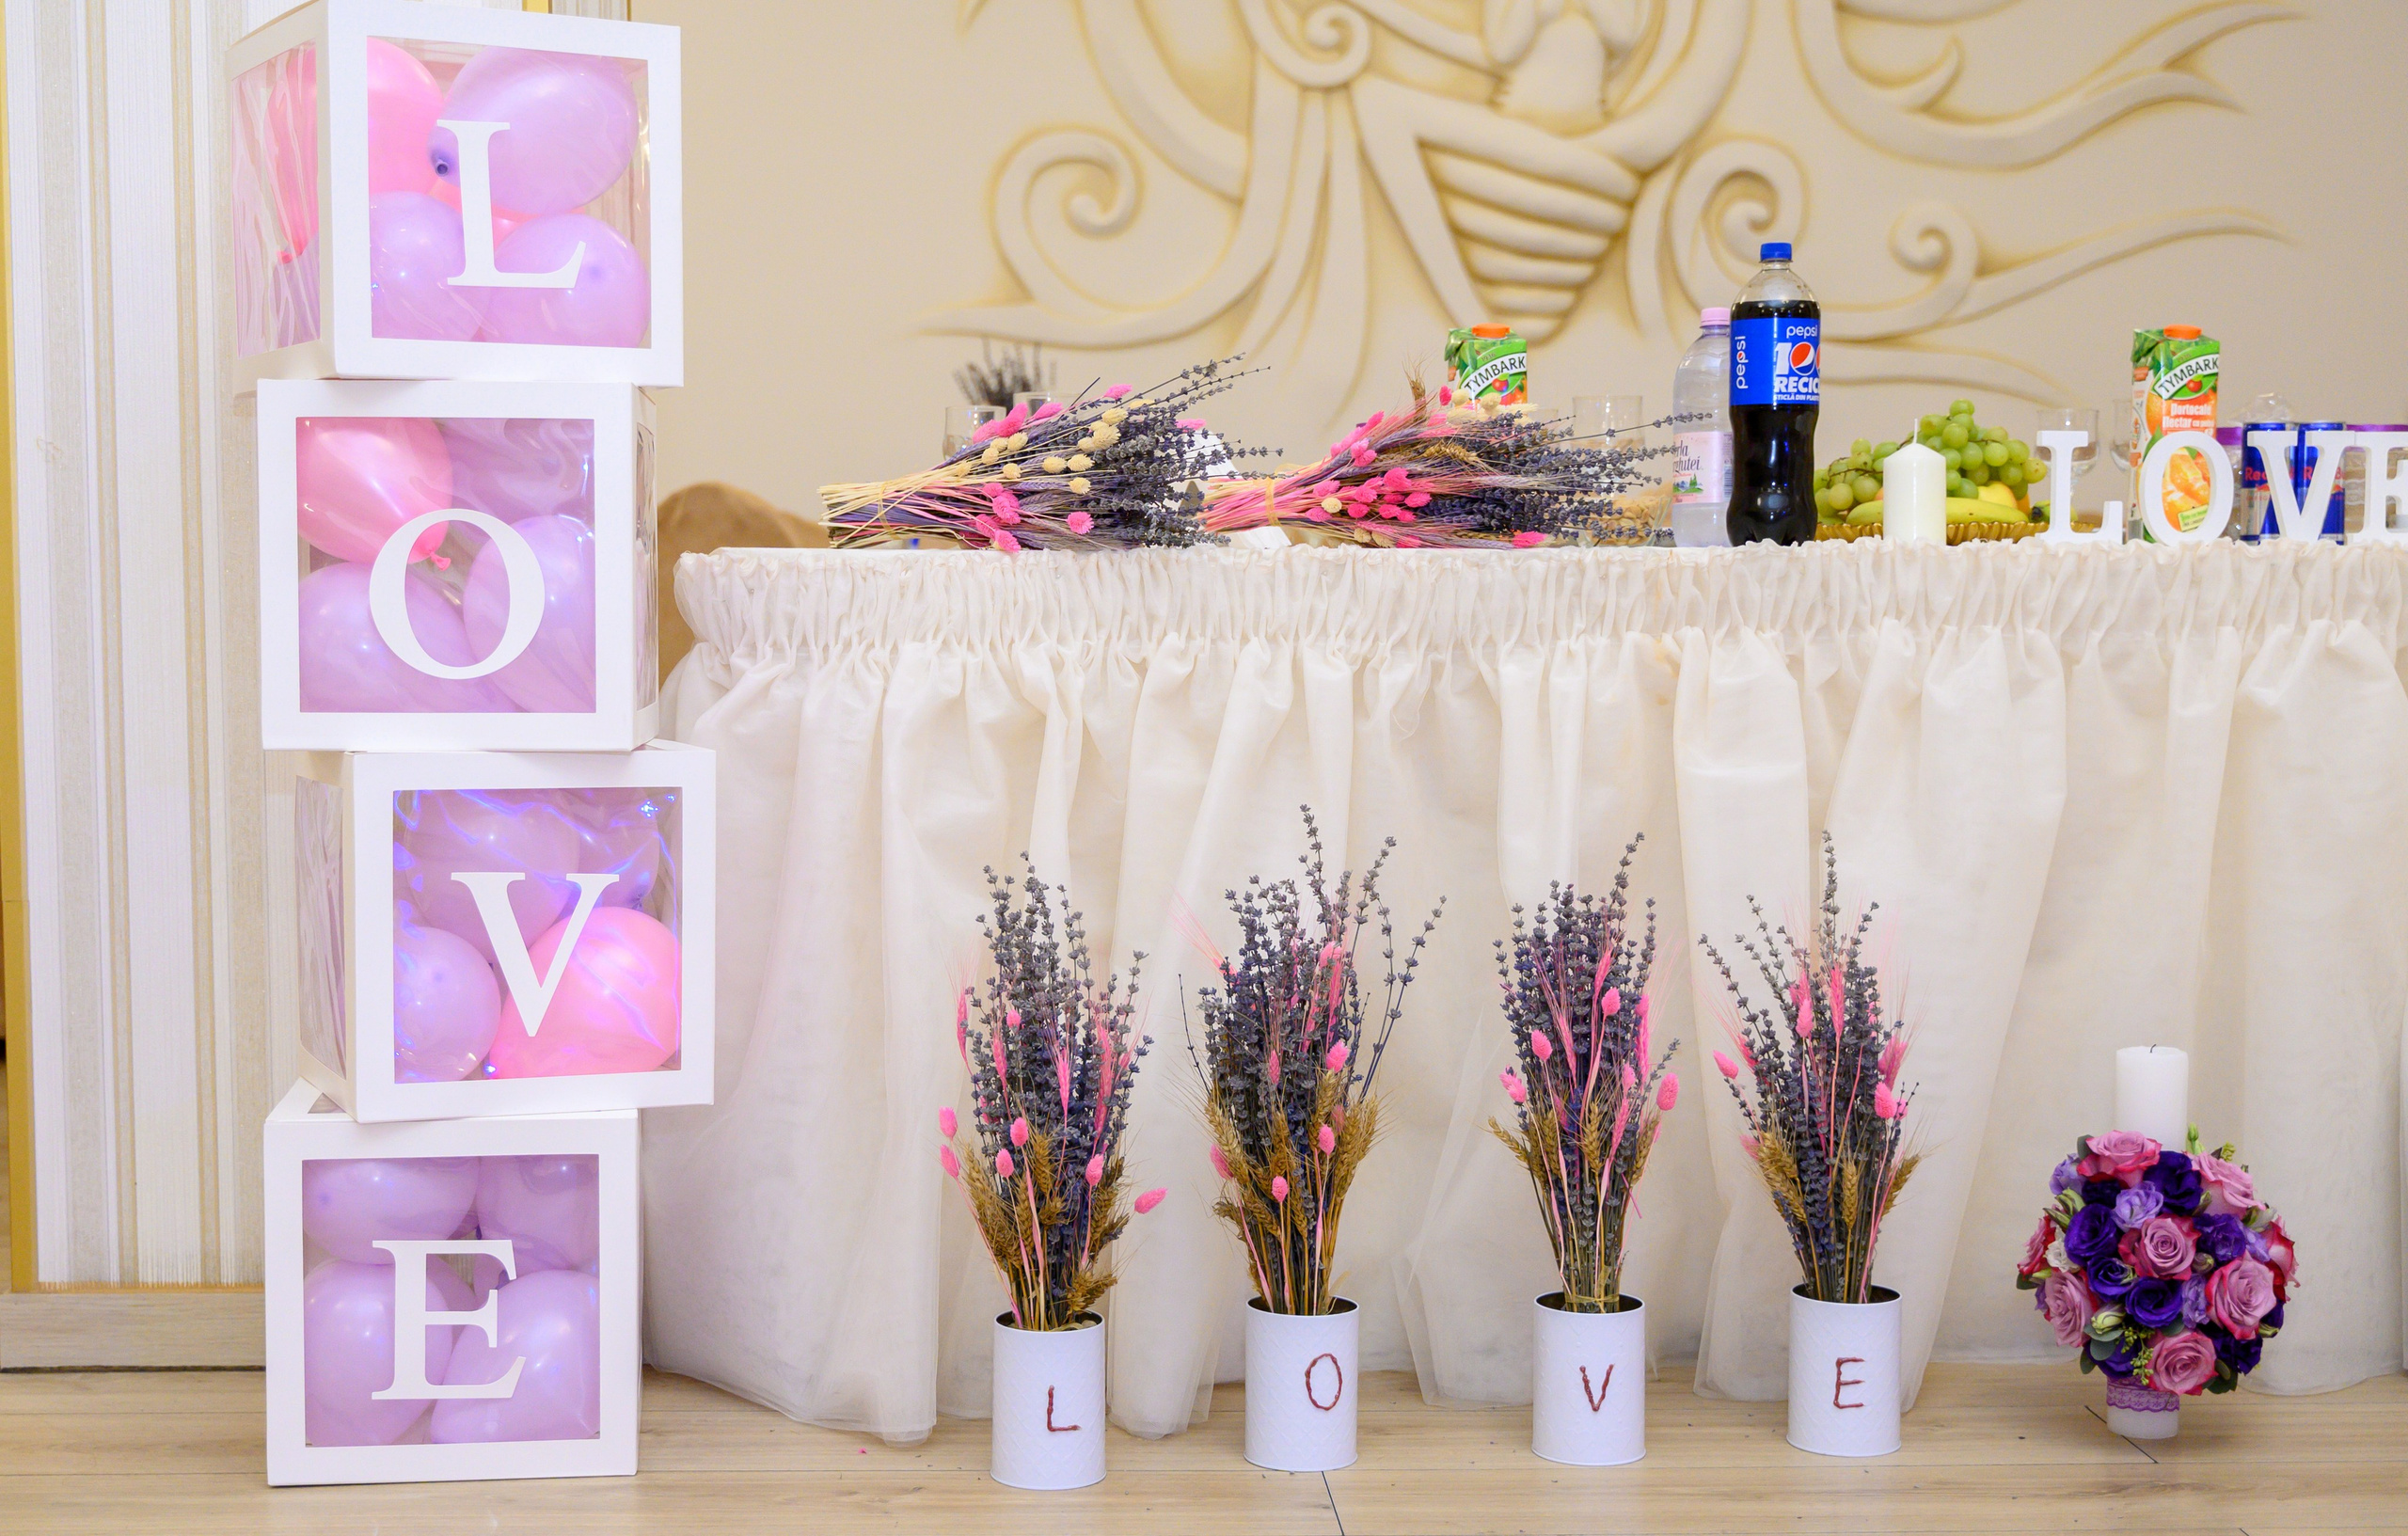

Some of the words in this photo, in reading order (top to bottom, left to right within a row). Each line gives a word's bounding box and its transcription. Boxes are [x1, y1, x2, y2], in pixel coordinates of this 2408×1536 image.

[436, 119, 585, 288] L
[1735, 335, 1749, 389] pepsi
[1786, 325, 1818, 339] pepsi
[1464, 356, 1526, 392] TYMBARK
[2158, 356, 2219, 393] TYMBARK
[369, 509, 546, 679] O
[452, 872, 620, 1037] V
[372, 1239, 527, 1401] E
[1047, 1385, 1081, 1432] L
[1305, 1353, 1343, 1411] O
[1578, 1363, 1615, 1412] V
[1832, 1356, 1866, 1409] E
